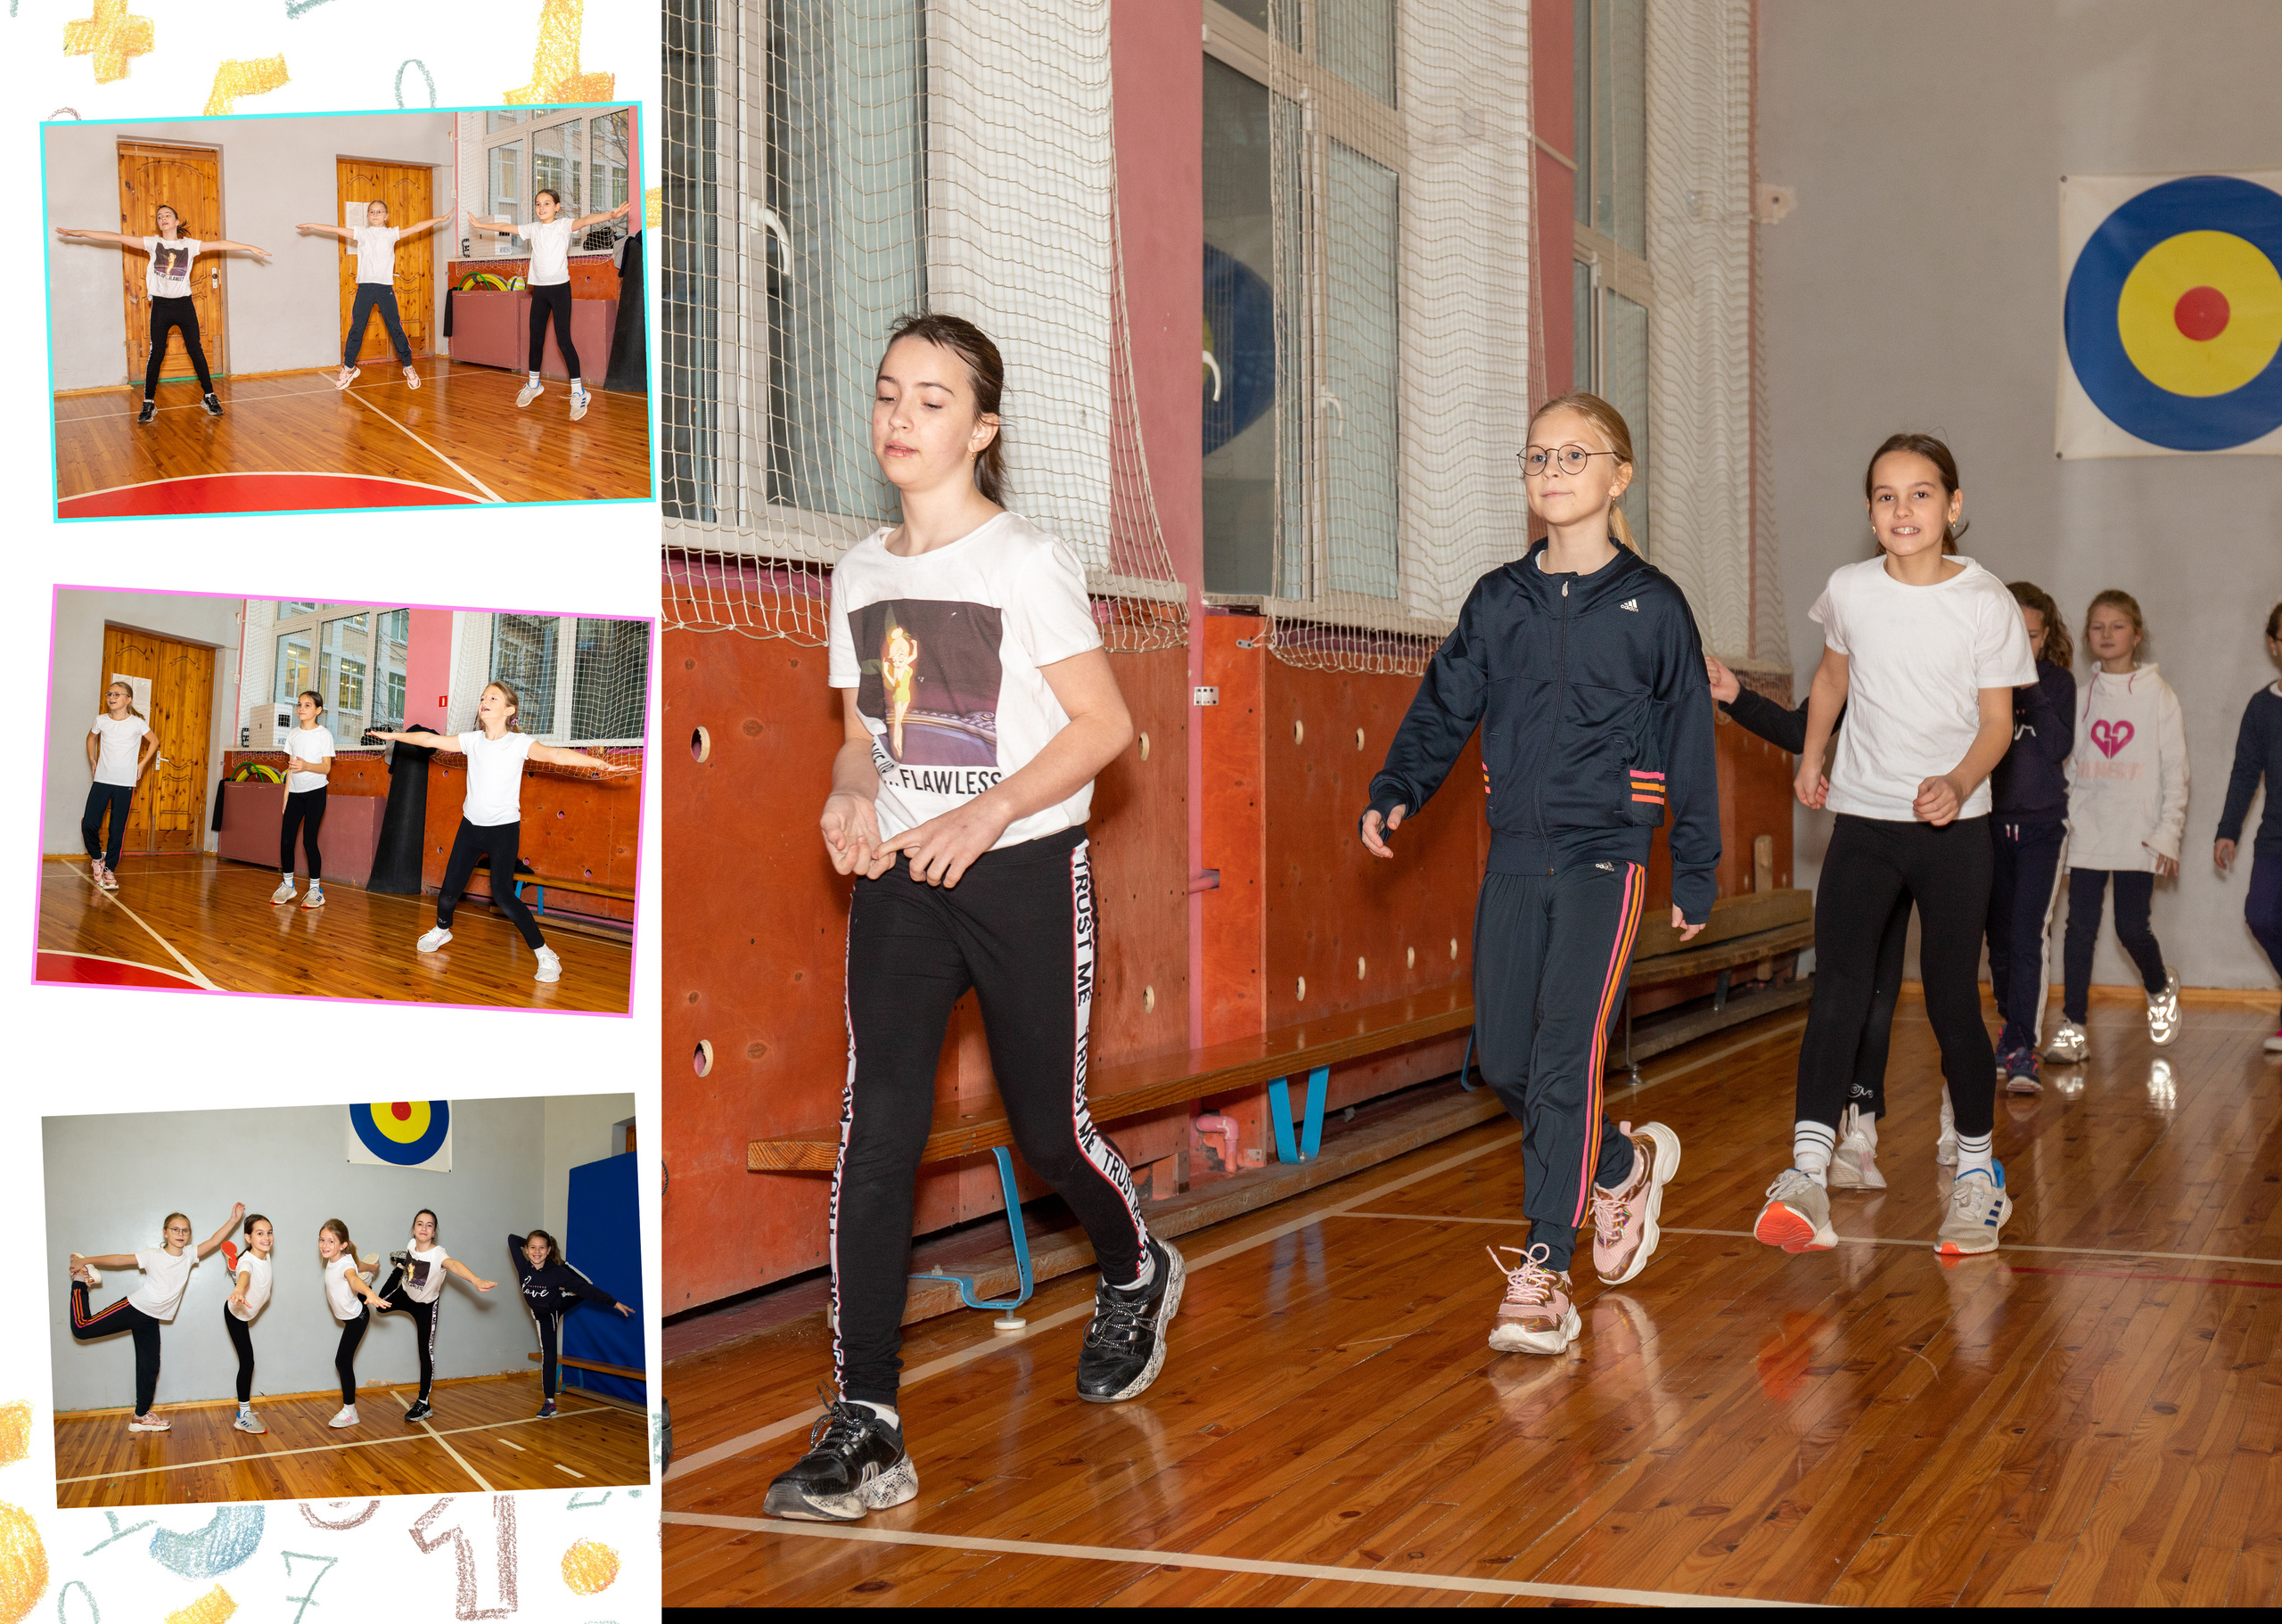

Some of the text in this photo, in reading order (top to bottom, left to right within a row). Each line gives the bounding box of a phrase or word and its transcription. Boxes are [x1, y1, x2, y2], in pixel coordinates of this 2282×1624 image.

[899, 768, 1002, 795] FLAWLESS
[1073, 854, 1093, 950] TRUST
[1077, 960, 1093, 1008] ME
[1075, 1024, 1089, 1117] TRUST
[1077, 1116, 1095, 1155] ME
[1102, 1147, 1137, 1202] TRUST
